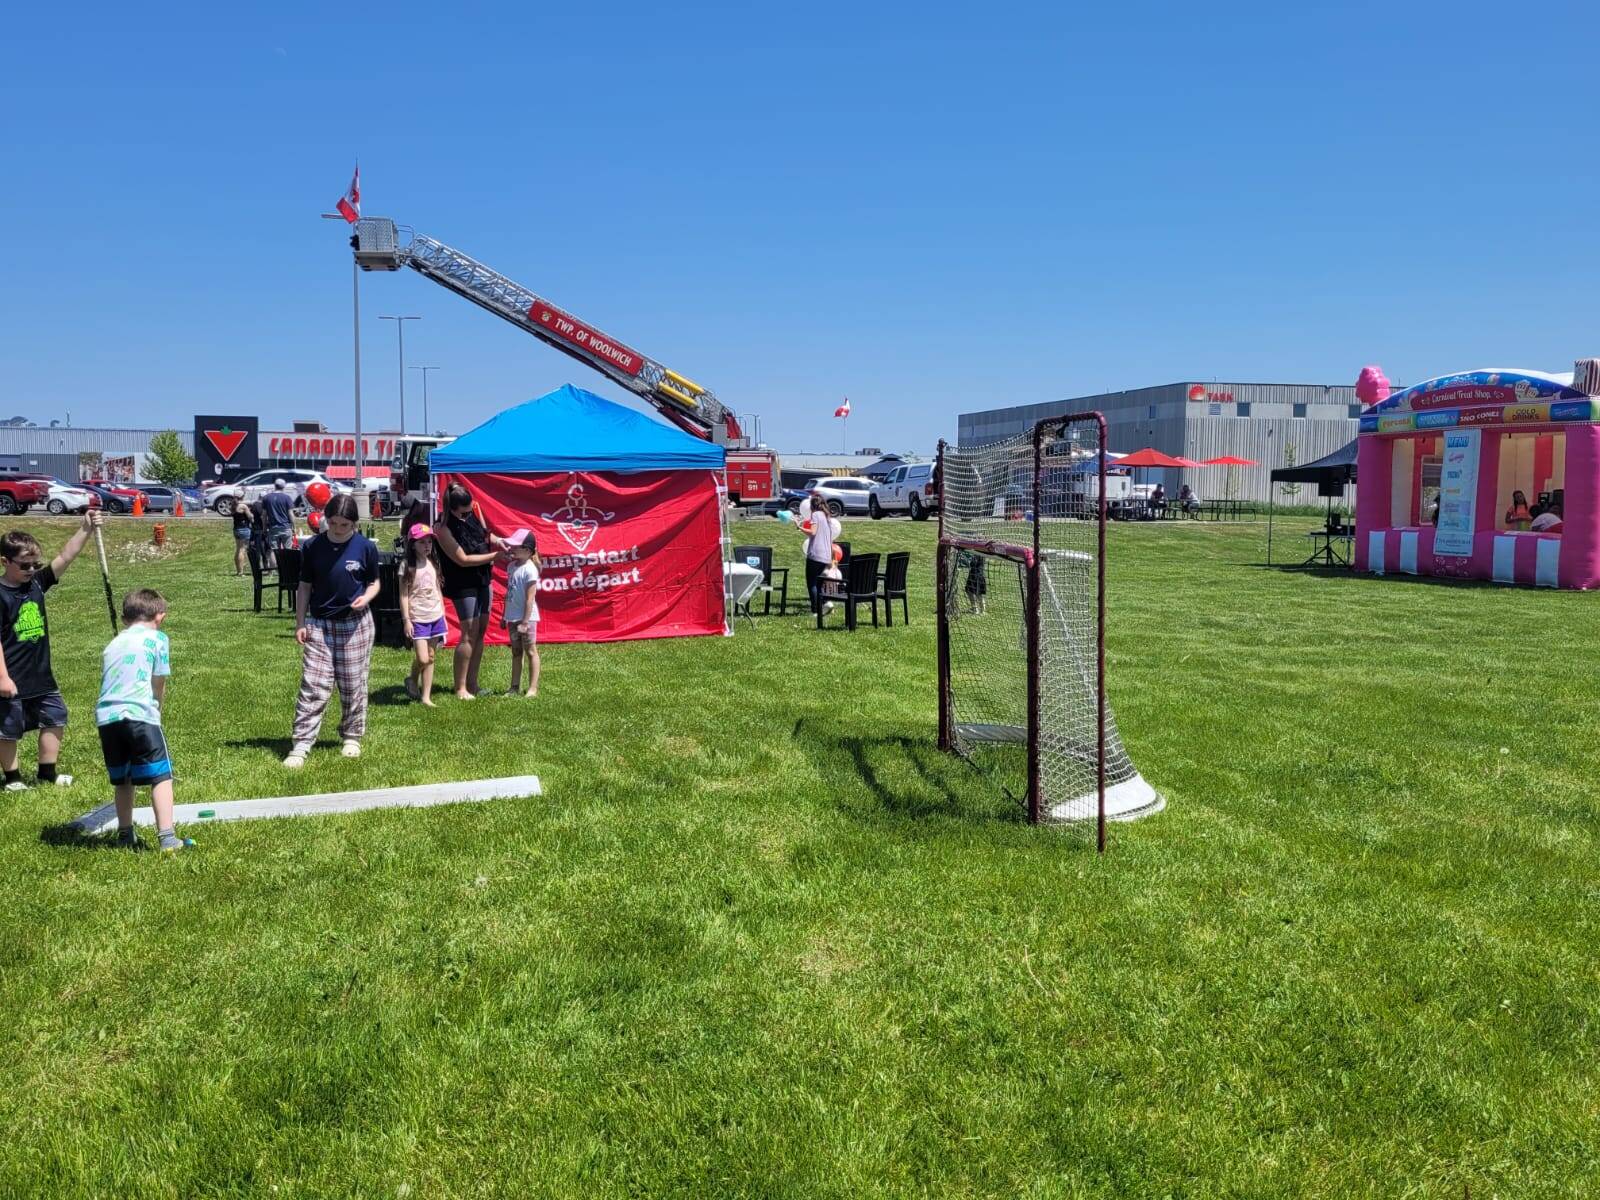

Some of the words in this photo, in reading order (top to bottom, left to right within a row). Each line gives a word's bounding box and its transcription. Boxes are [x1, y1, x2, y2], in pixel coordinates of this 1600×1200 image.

[555, 318, 574, 336] TWP.
[576, 330, 589, 342] OF
[589, 336, 632, 367] WOOLWICH
[1432, 392, 1456, 402] Carnival
[1457, 390, 1473, 399] Treat
[1474, 390, 1491, 399] Shop
[1460, 414, 1475, 422] SNO
[270, 437, 369, 457] CANADIAN
[1447, 436, 1470, 448] MENU
[747, 483, 758, 492] 911
[541, 545, 640, 571] umpstart
[570, 567, 643, 592] départ
